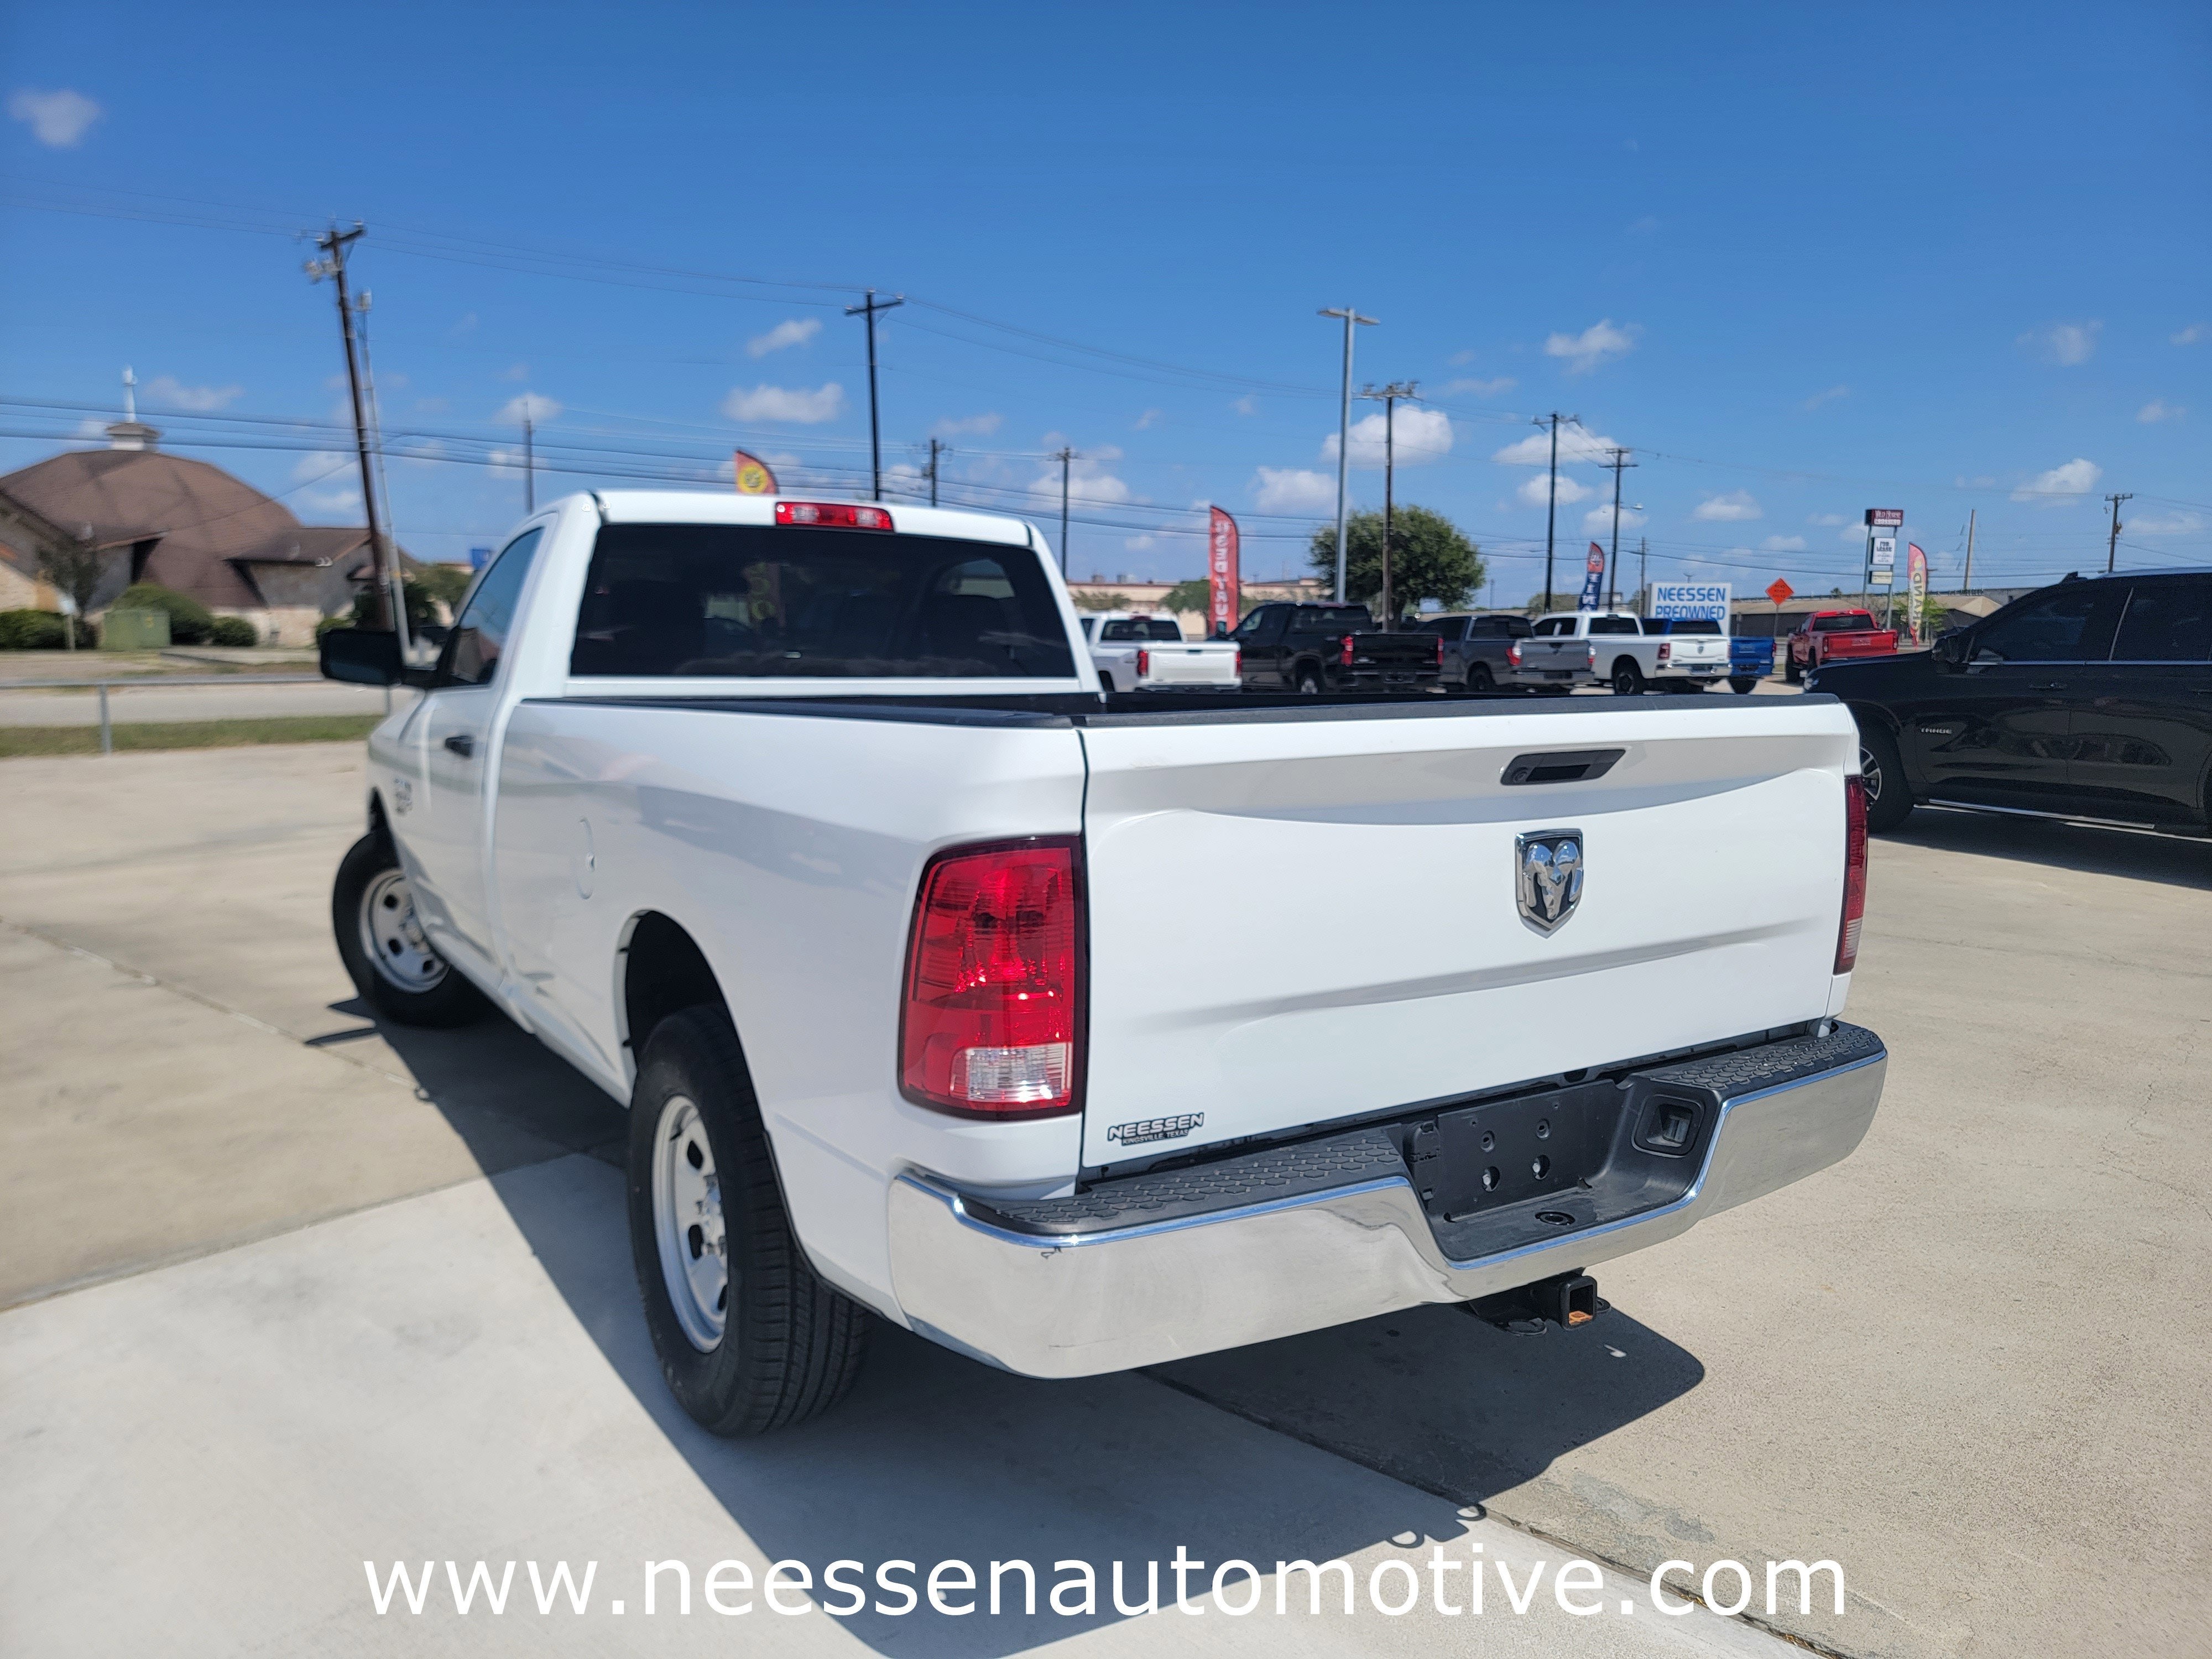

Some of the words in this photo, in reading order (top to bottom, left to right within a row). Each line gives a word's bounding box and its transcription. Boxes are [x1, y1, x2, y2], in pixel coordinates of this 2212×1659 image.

[1657, 587, 1725, 602] NEESSEN
[1655, 606, 1725, 620] PREOWNED
[1108, 1113, 1204, 1141] NEESSEN
[1167, 1129, 1188, 1138] TEXAS
